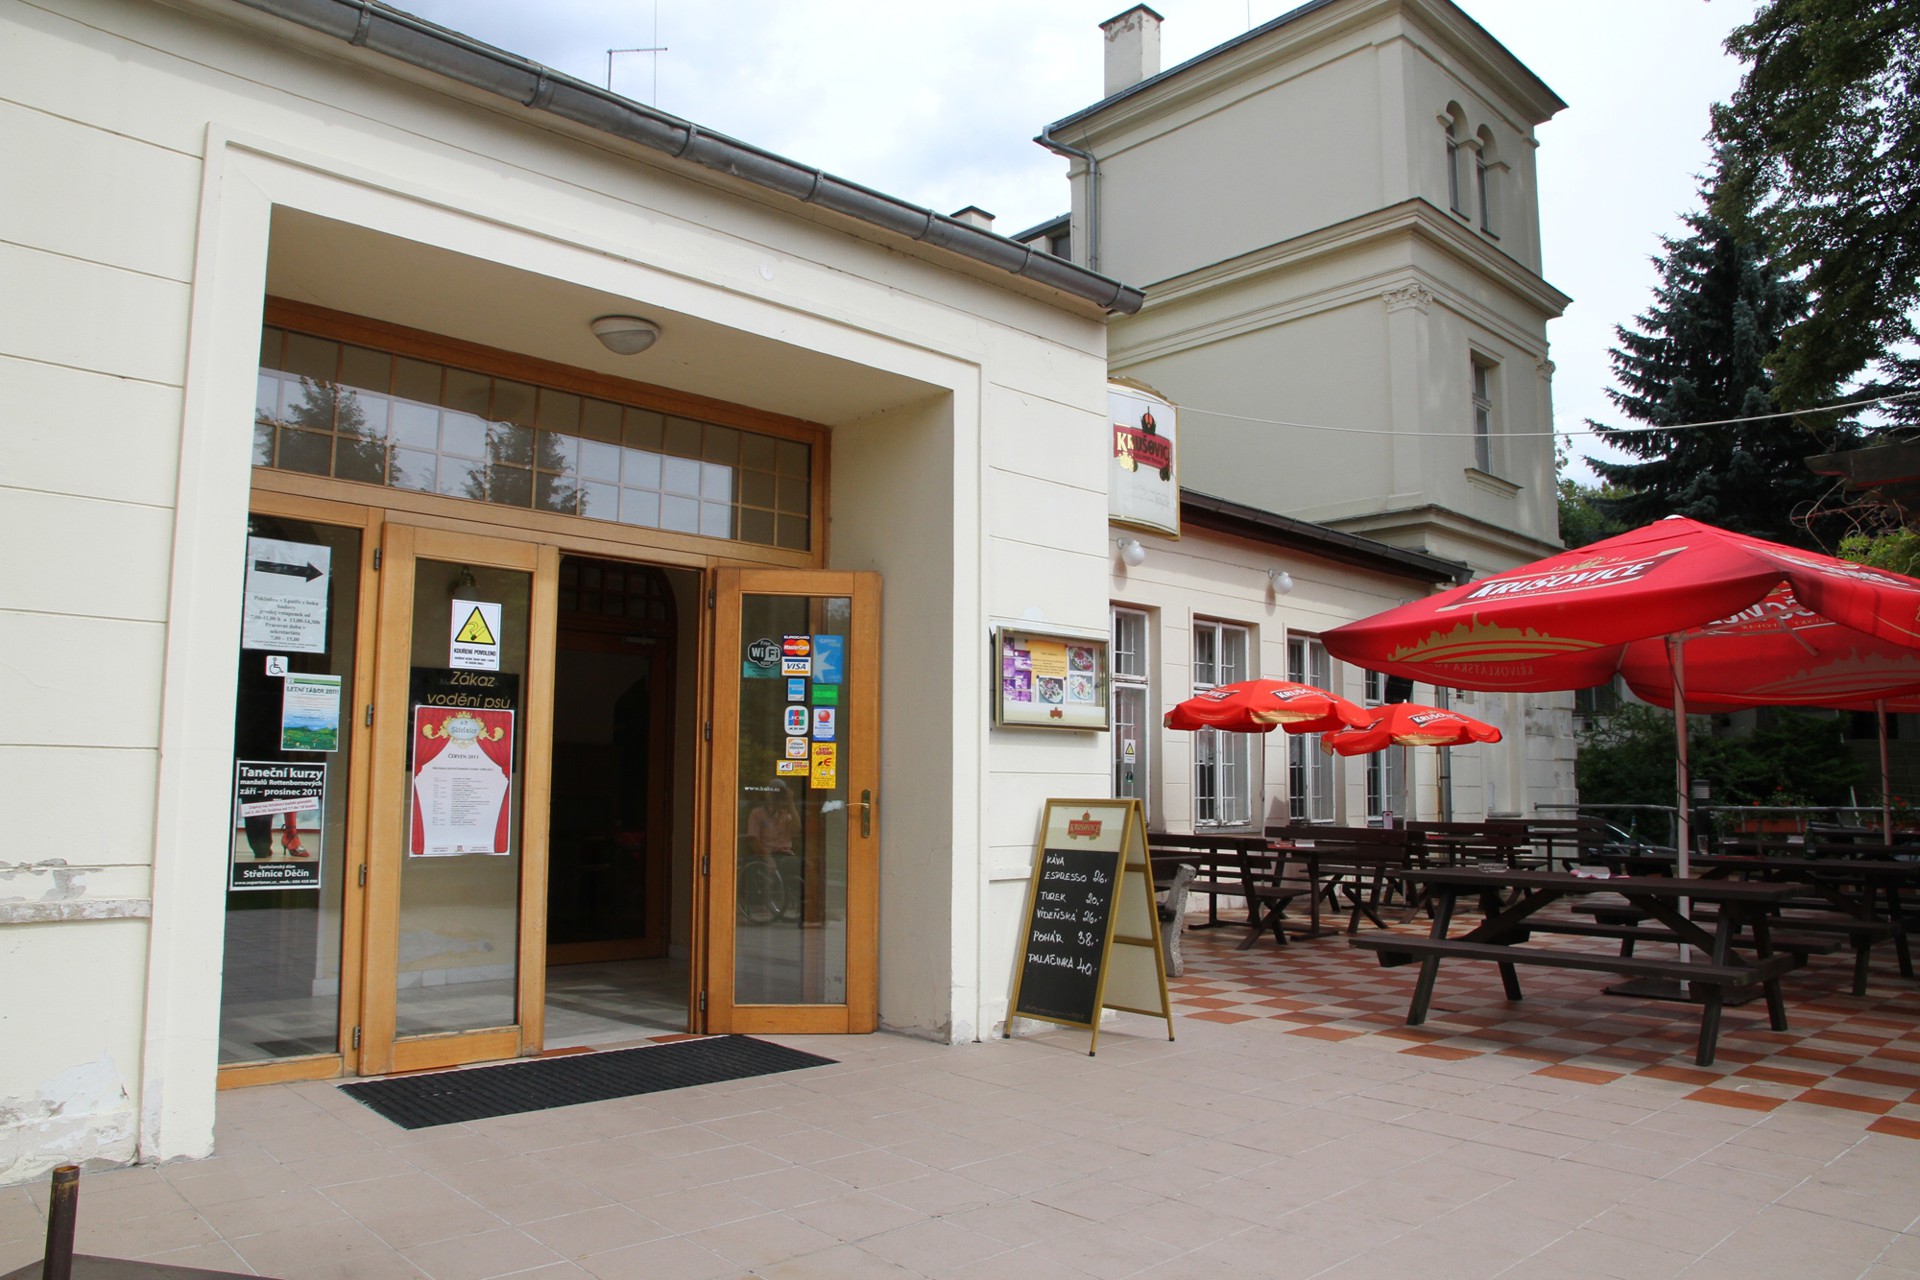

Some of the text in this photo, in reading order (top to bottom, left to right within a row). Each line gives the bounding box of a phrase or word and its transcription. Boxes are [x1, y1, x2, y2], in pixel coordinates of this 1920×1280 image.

[1468, 561, 1654, 599] KRUŠOVICE
[450, 671, 496, 687] Zákaz
[305, 686, 325, 694] TÁBOR
[427, 693, 511, 709] vodění psů
[241, 766, 323, 780] Taneční kurzy
[240, 787, 256, 795] září
[264, 788, 301, 799] prosinec
[301, 788, 322, 796] 2011
[1069, 821, 1100, 833] KRUŠOVICE
[1046, 853, 1065, 867] KÁVA
[243, 868, 309, 878] Střelnice Děčín
[1044, 871, 1087, 883] ESPRESSO
[1039, 891, 1067, 903] TUREK
[1033, 930, 1064, 944] POHÁR
[1027, 953, 1074, 970] PALAČINKA
